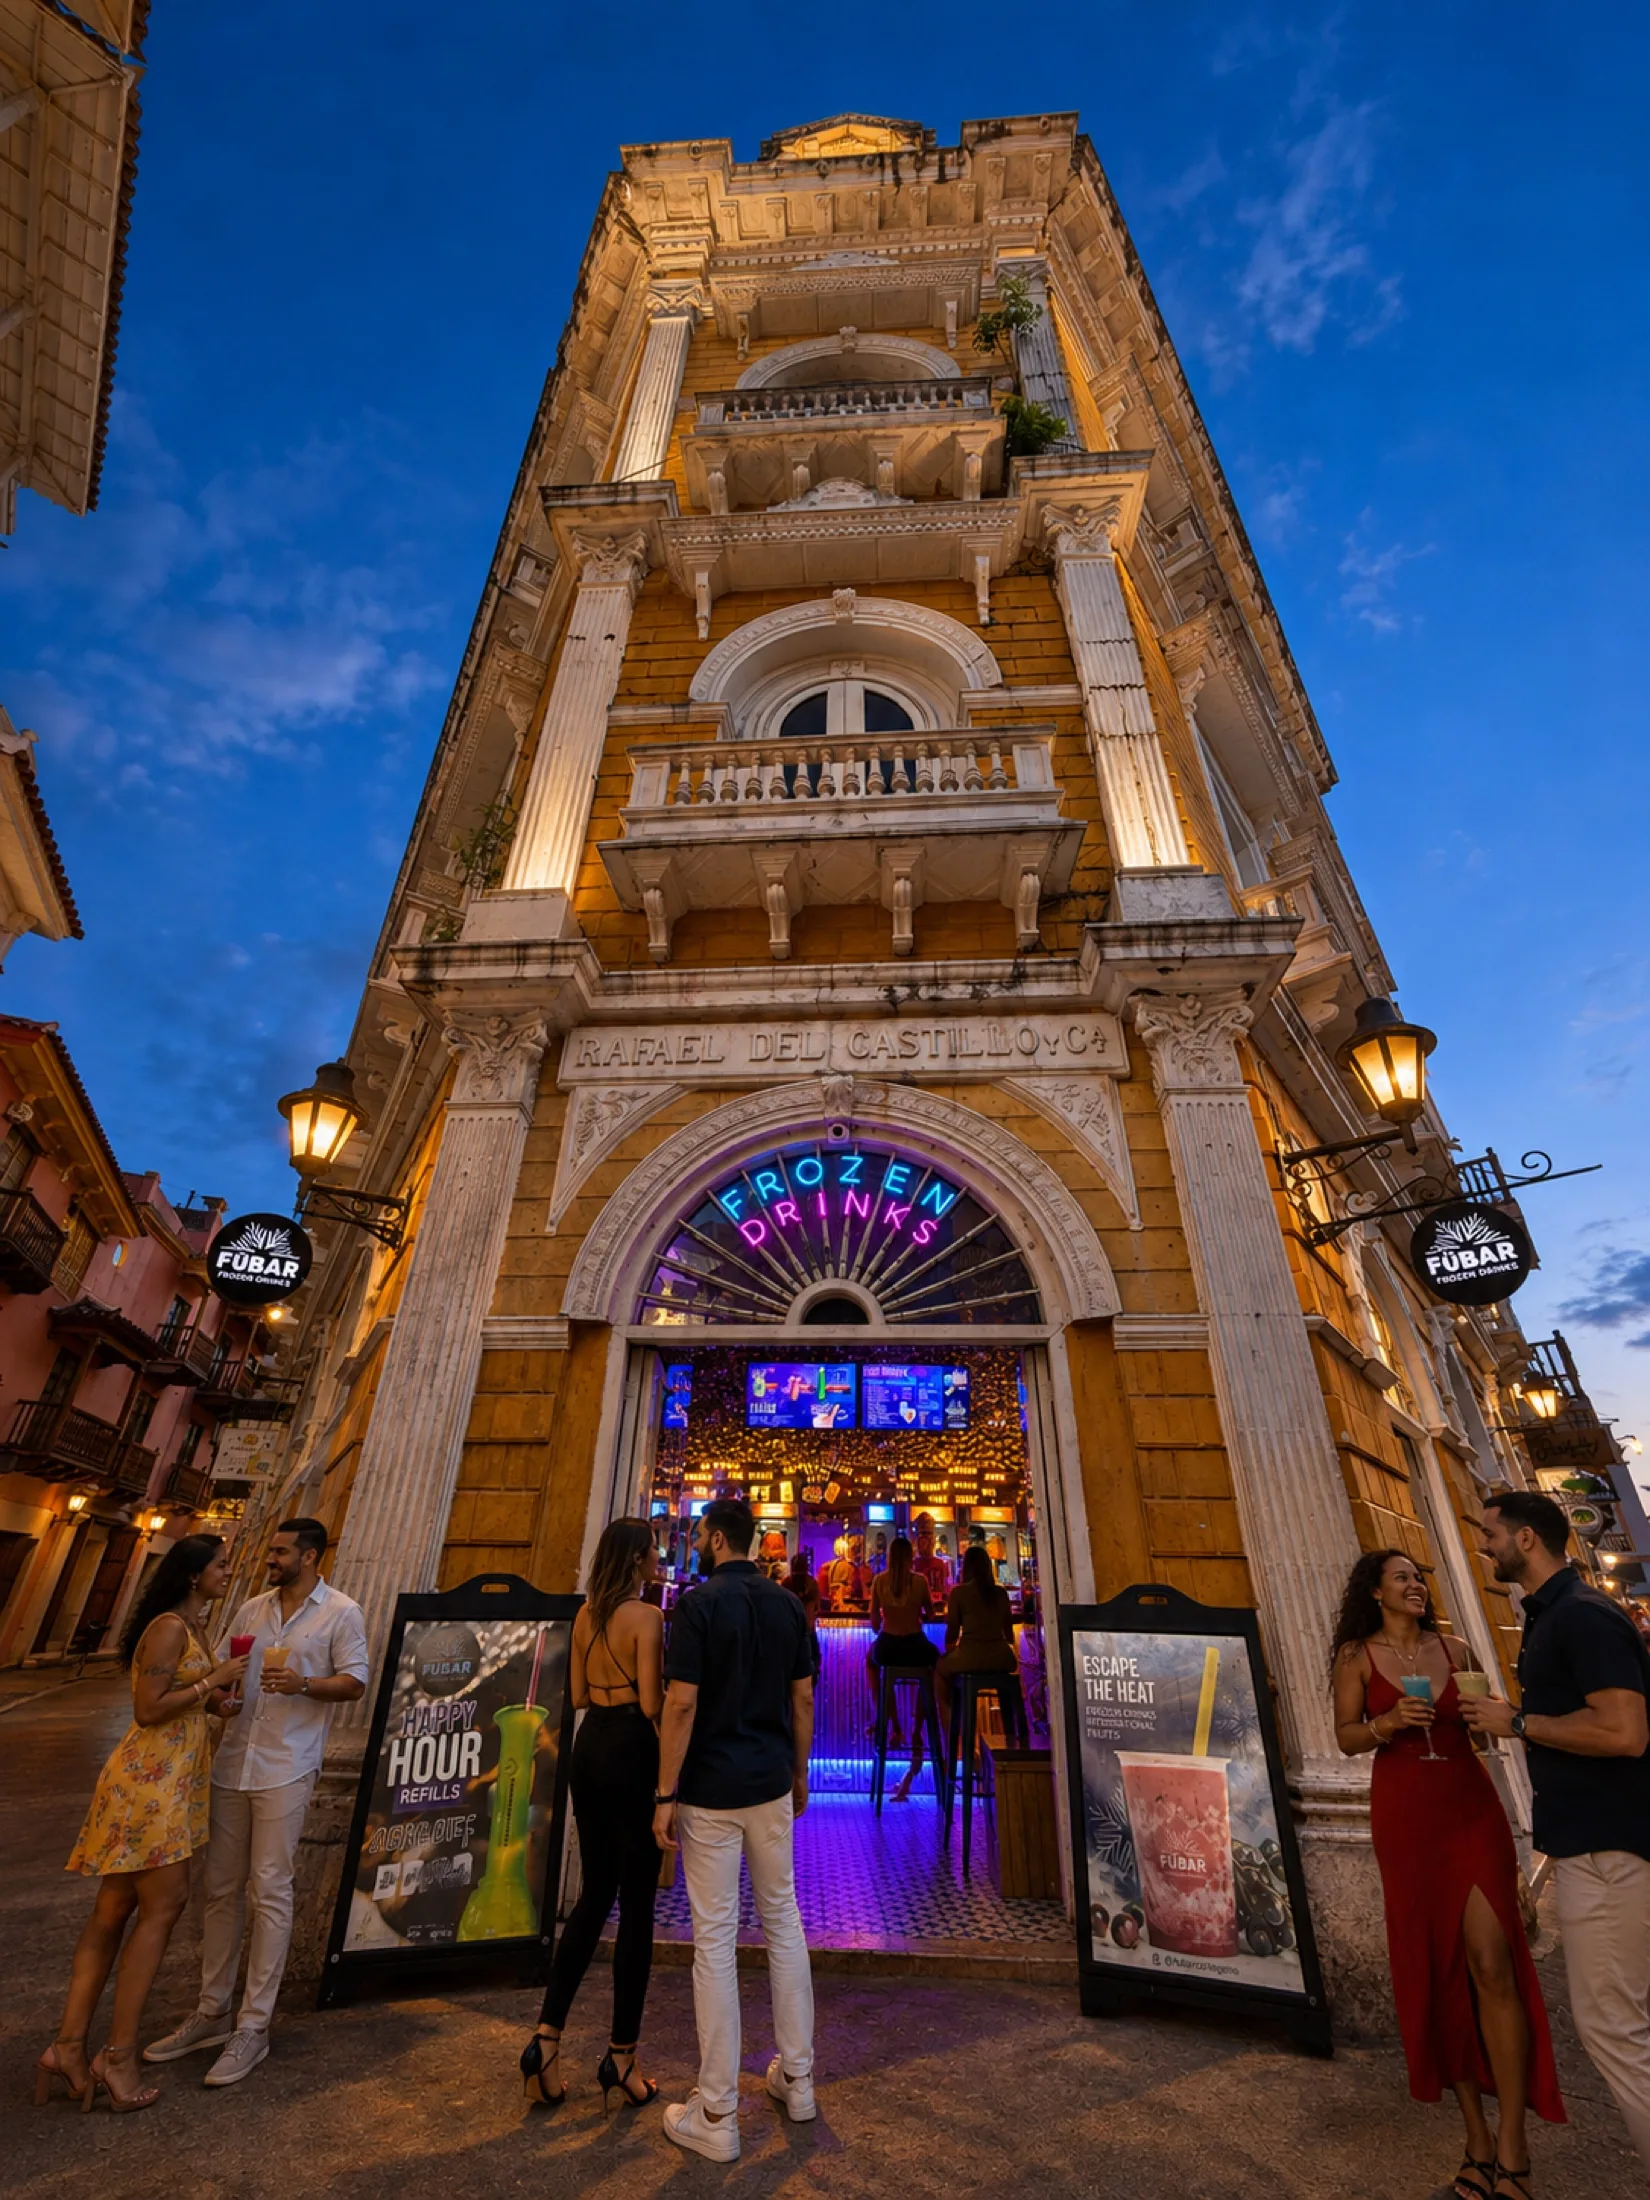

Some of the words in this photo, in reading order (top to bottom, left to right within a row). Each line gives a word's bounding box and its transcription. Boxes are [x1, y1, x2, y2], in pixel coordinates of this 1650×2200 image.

[574, 1033, 725, 1068] RAFAEL
[748, 1031, 826, 1063] DEL
[720, 1154, 955, 1220] FROZEN
[738, 1189, 939, 1246] DRINKS
[1082, 1655, 1141, 1678] ESCAPE
[1084, 1678, 1115, 1701] THE
[1116, 1679, 1156, 1705] HEAT
[401, 1699, 478, 1739] HAPPY
[386, 1731, 482, 1788] HOUR
[399, 1783, 461, 1805] REFILLS
